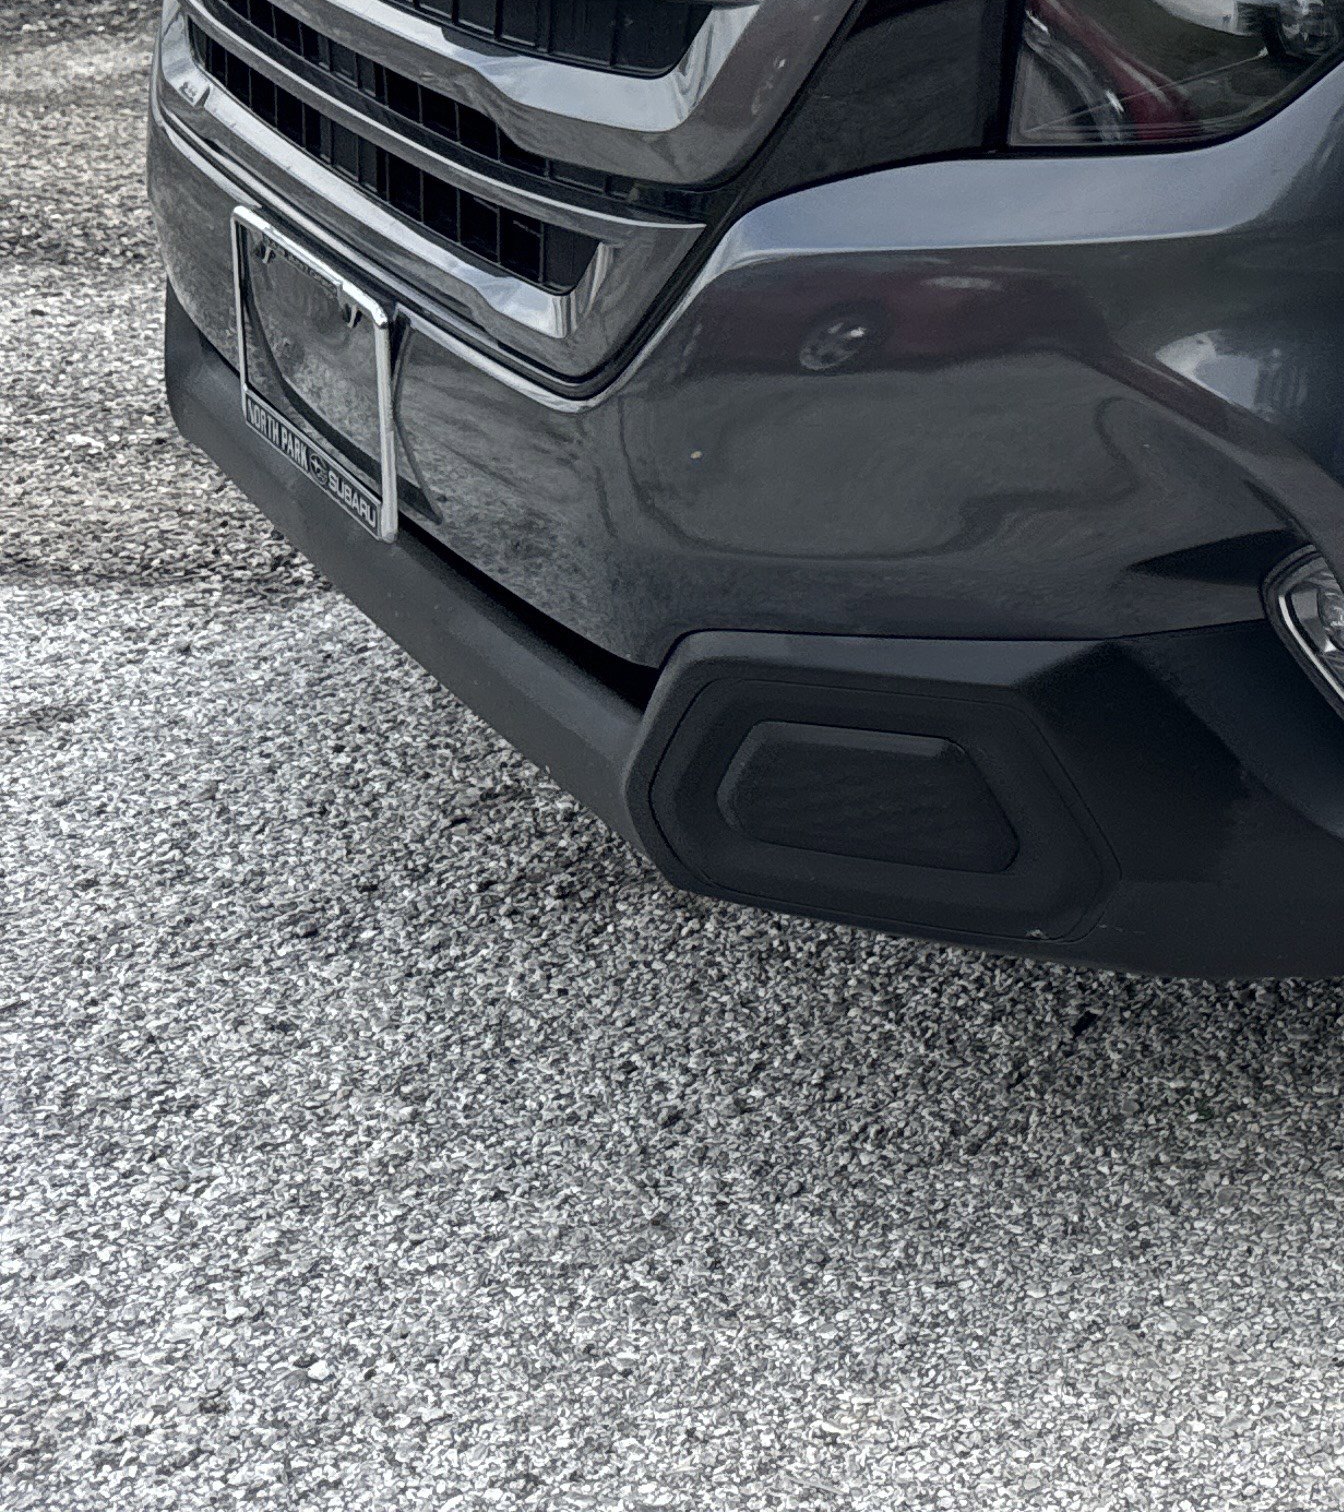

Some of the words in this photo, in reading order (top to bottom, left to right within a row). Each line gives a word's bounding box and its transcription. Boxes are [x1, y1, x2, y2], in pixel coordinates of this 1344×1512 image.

[247, 397, 281, 446] NORTH
[281, 426, 310, 472] PARK
[327, 470, 377, 528] SUBARU
